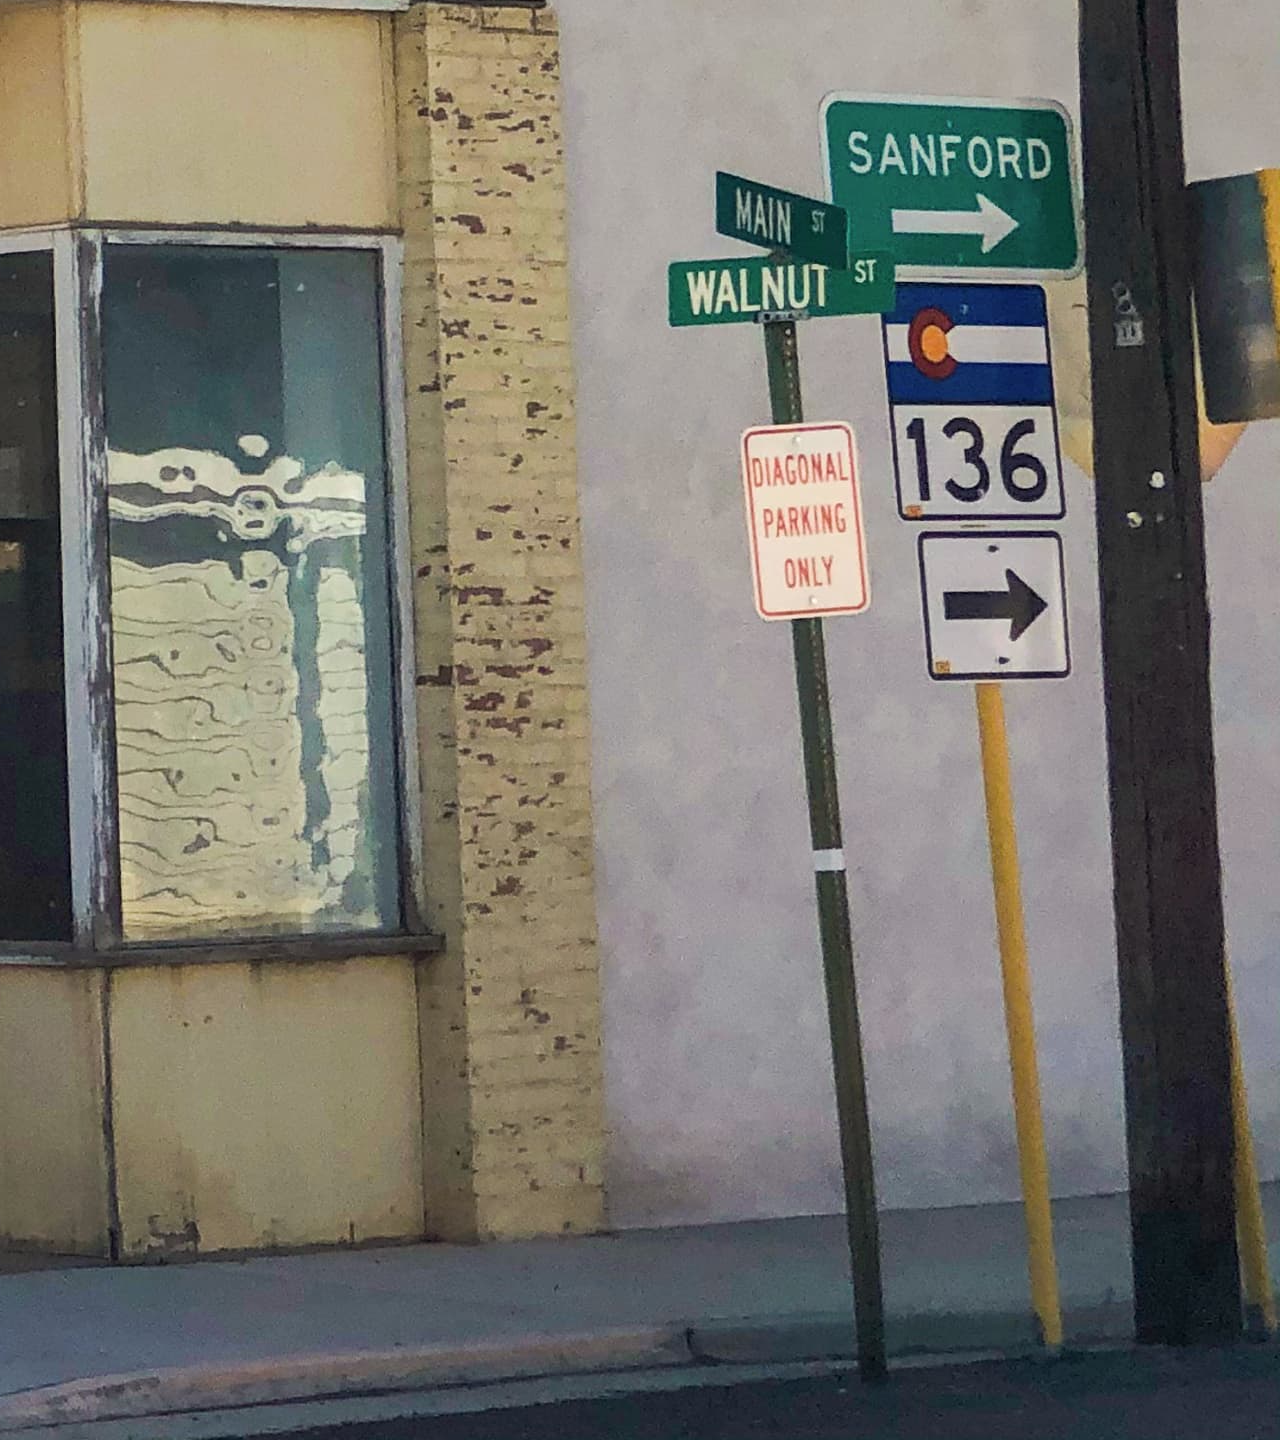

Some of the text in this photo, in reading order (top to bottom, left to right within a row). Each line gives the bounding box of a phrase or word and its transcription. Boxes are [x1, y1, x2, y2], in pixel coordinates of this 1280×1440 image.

[848, 130, 1051, 180] SANFORD
[735, 187, 825, 246] MAIN ST
[686, 259, 877, 315] WALNUT ST
[750, 451, 849, 489] DIAGONAL
[906, 416, 1048, 503] 136
[762, 503, 847, 539] PARKING
[783, 555, 835, 589] ONLY
